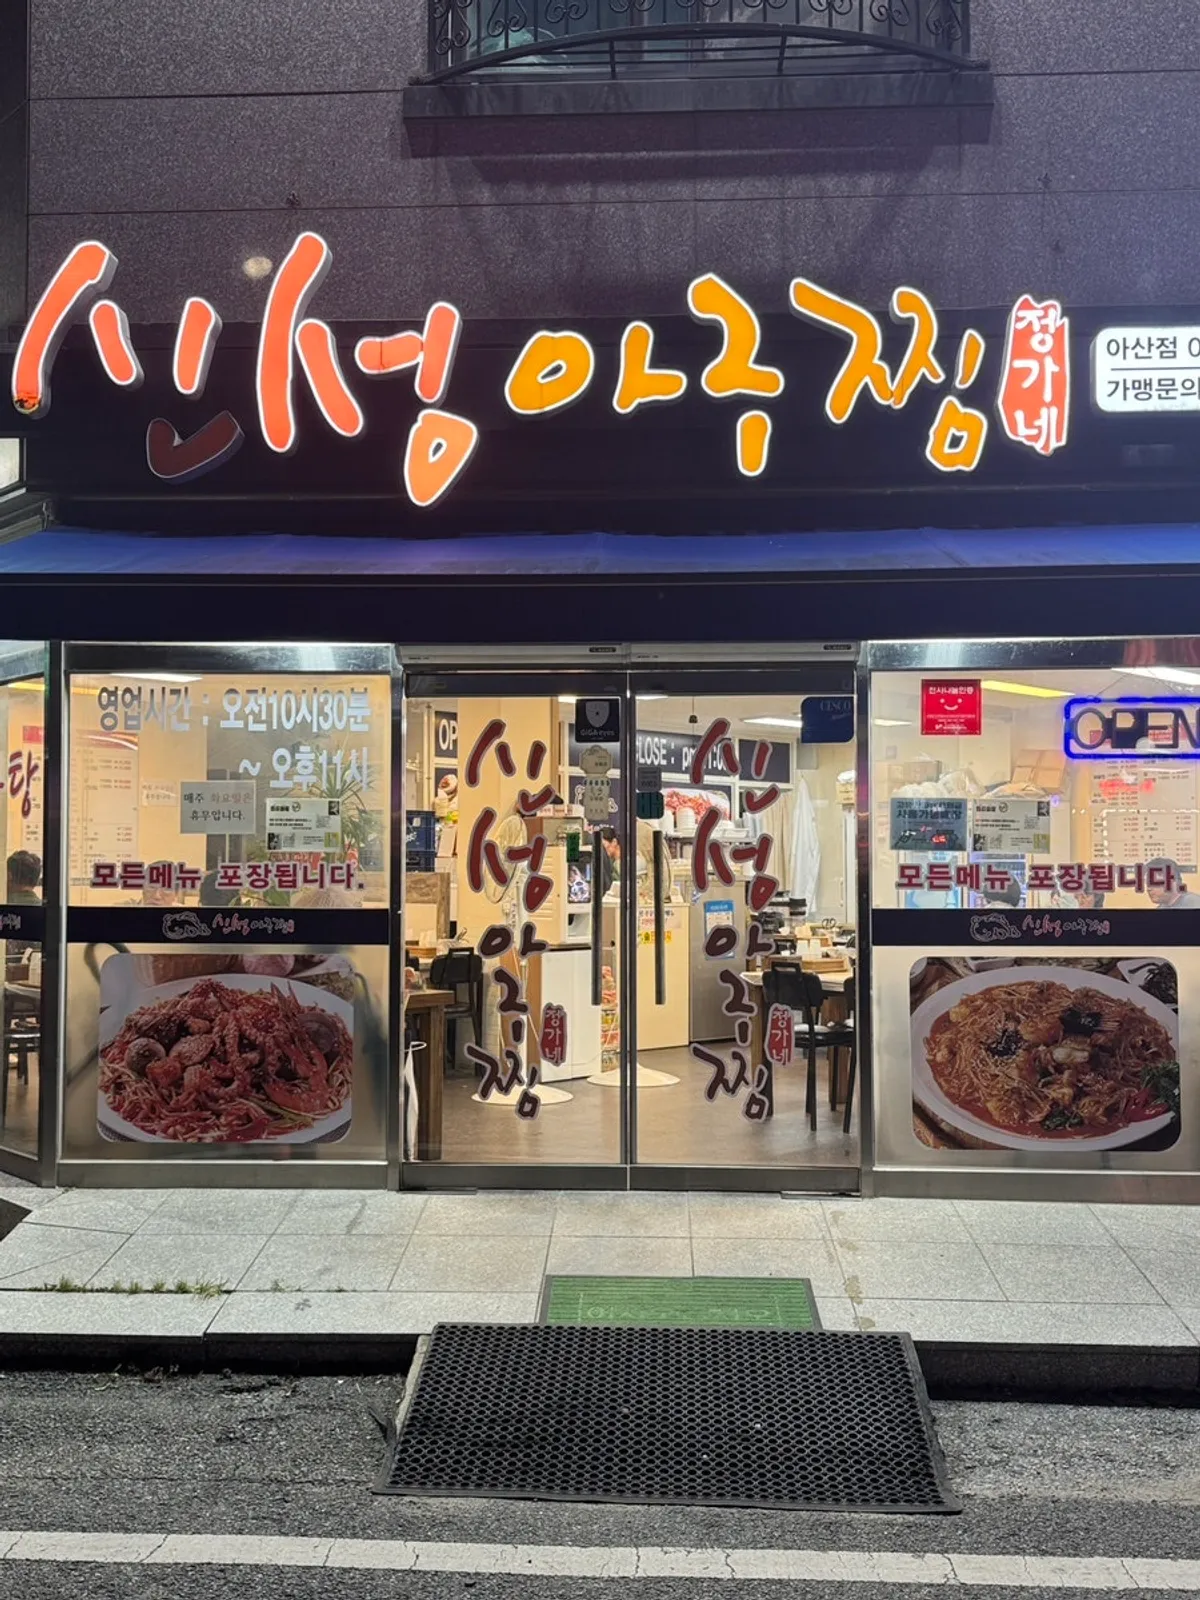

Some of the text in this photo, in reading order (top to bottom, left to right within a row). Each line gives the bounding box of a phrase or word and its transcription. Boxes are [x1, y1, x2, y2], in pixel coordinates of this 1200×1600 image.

[1107, 336, 1177, 360] 아산점
[1010, 304, 1067, 453] 정가네
[1107, 377, 1200, 401] 가맹문의
[97, 686, 191, 732] 영업시간
[220, 687, 371, 732] 오전10시30분
[1072, 707, 1200, 749] OPEN
[636, 736, 667, 765] LOSE
[0, 751, 39, 818] 탕
[270, 746, 368, 792] 오후11시
[91, 862, 366, 890] 모든메뉴 포장됩니다.
[896, 863, 1186, 892] 모든메뉴 포장됩니다.
